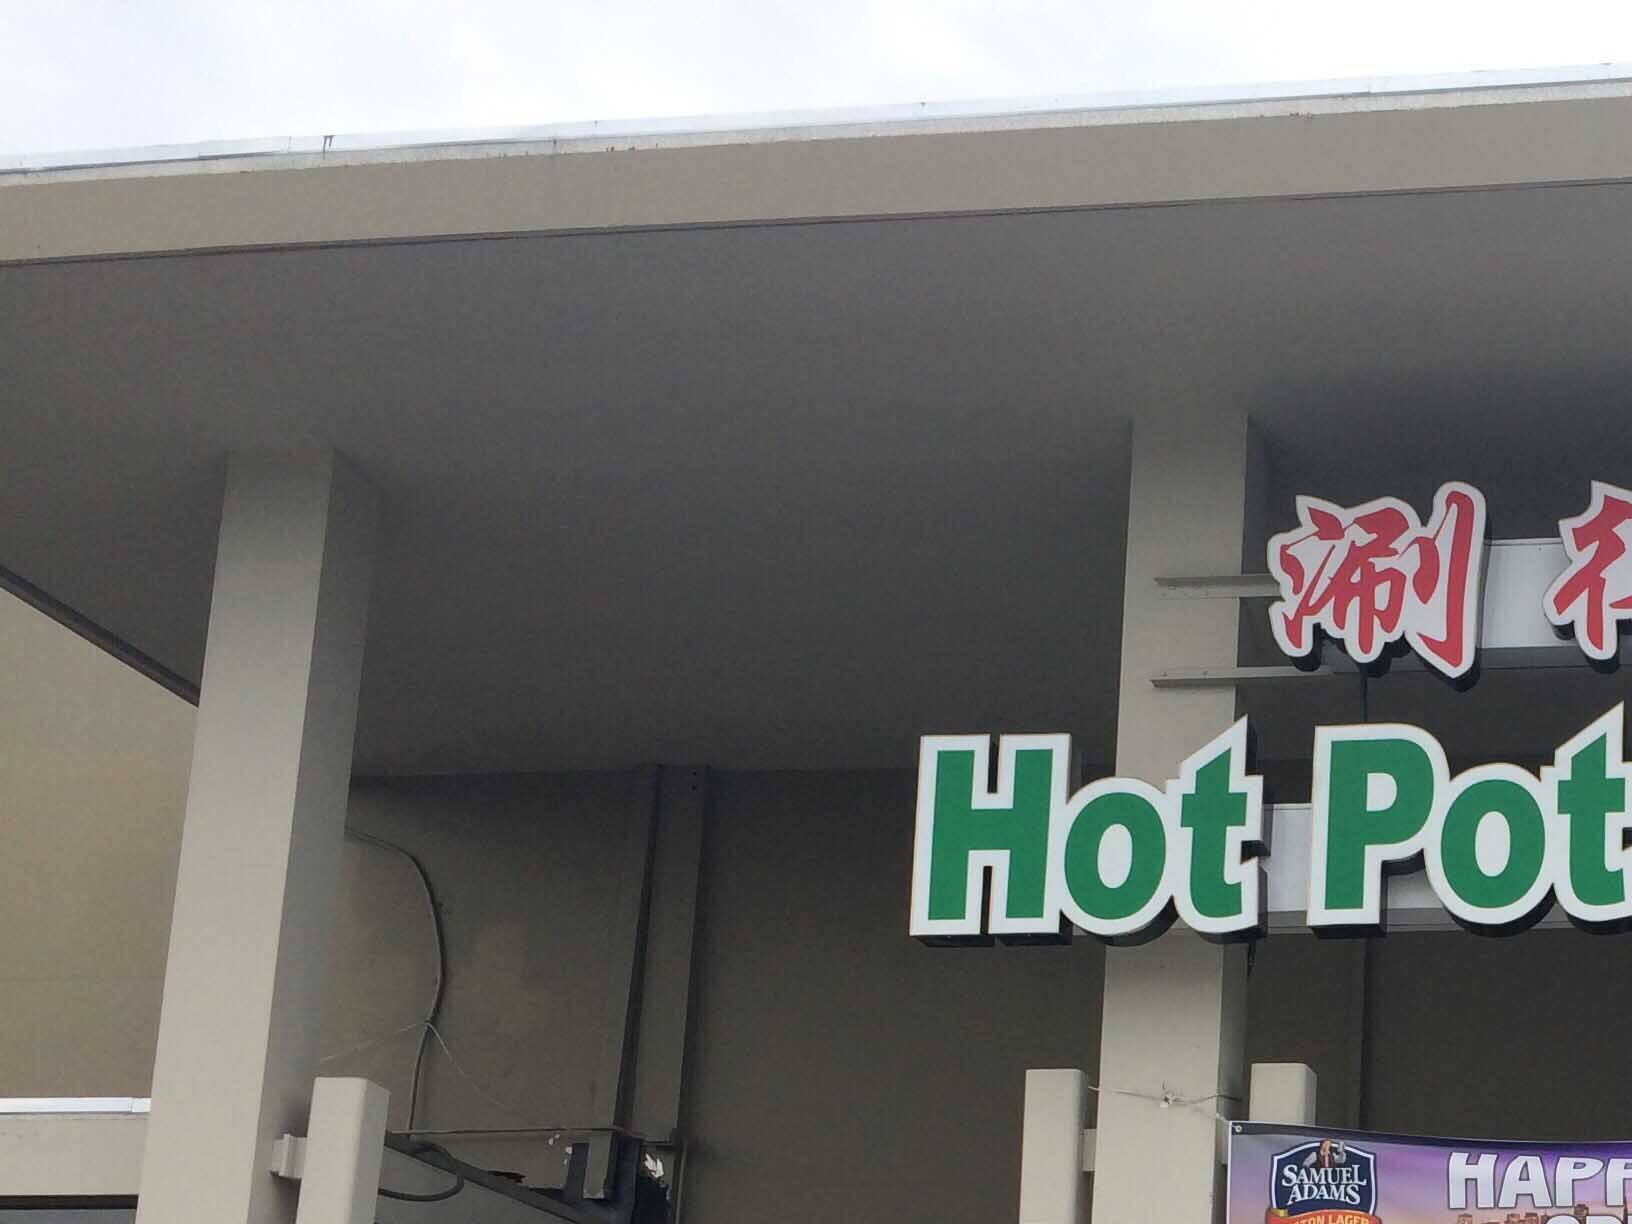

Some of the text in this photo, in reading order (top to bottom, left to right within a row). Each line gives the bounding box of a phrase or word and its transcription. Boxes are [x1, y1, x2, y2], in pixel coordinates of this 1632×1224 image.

[918, 732, 1258, 932] Hot
[1282, 1165, 1367, 1186] SAMUEL
[1287, 1185, 1361, 1205] ADAMS
